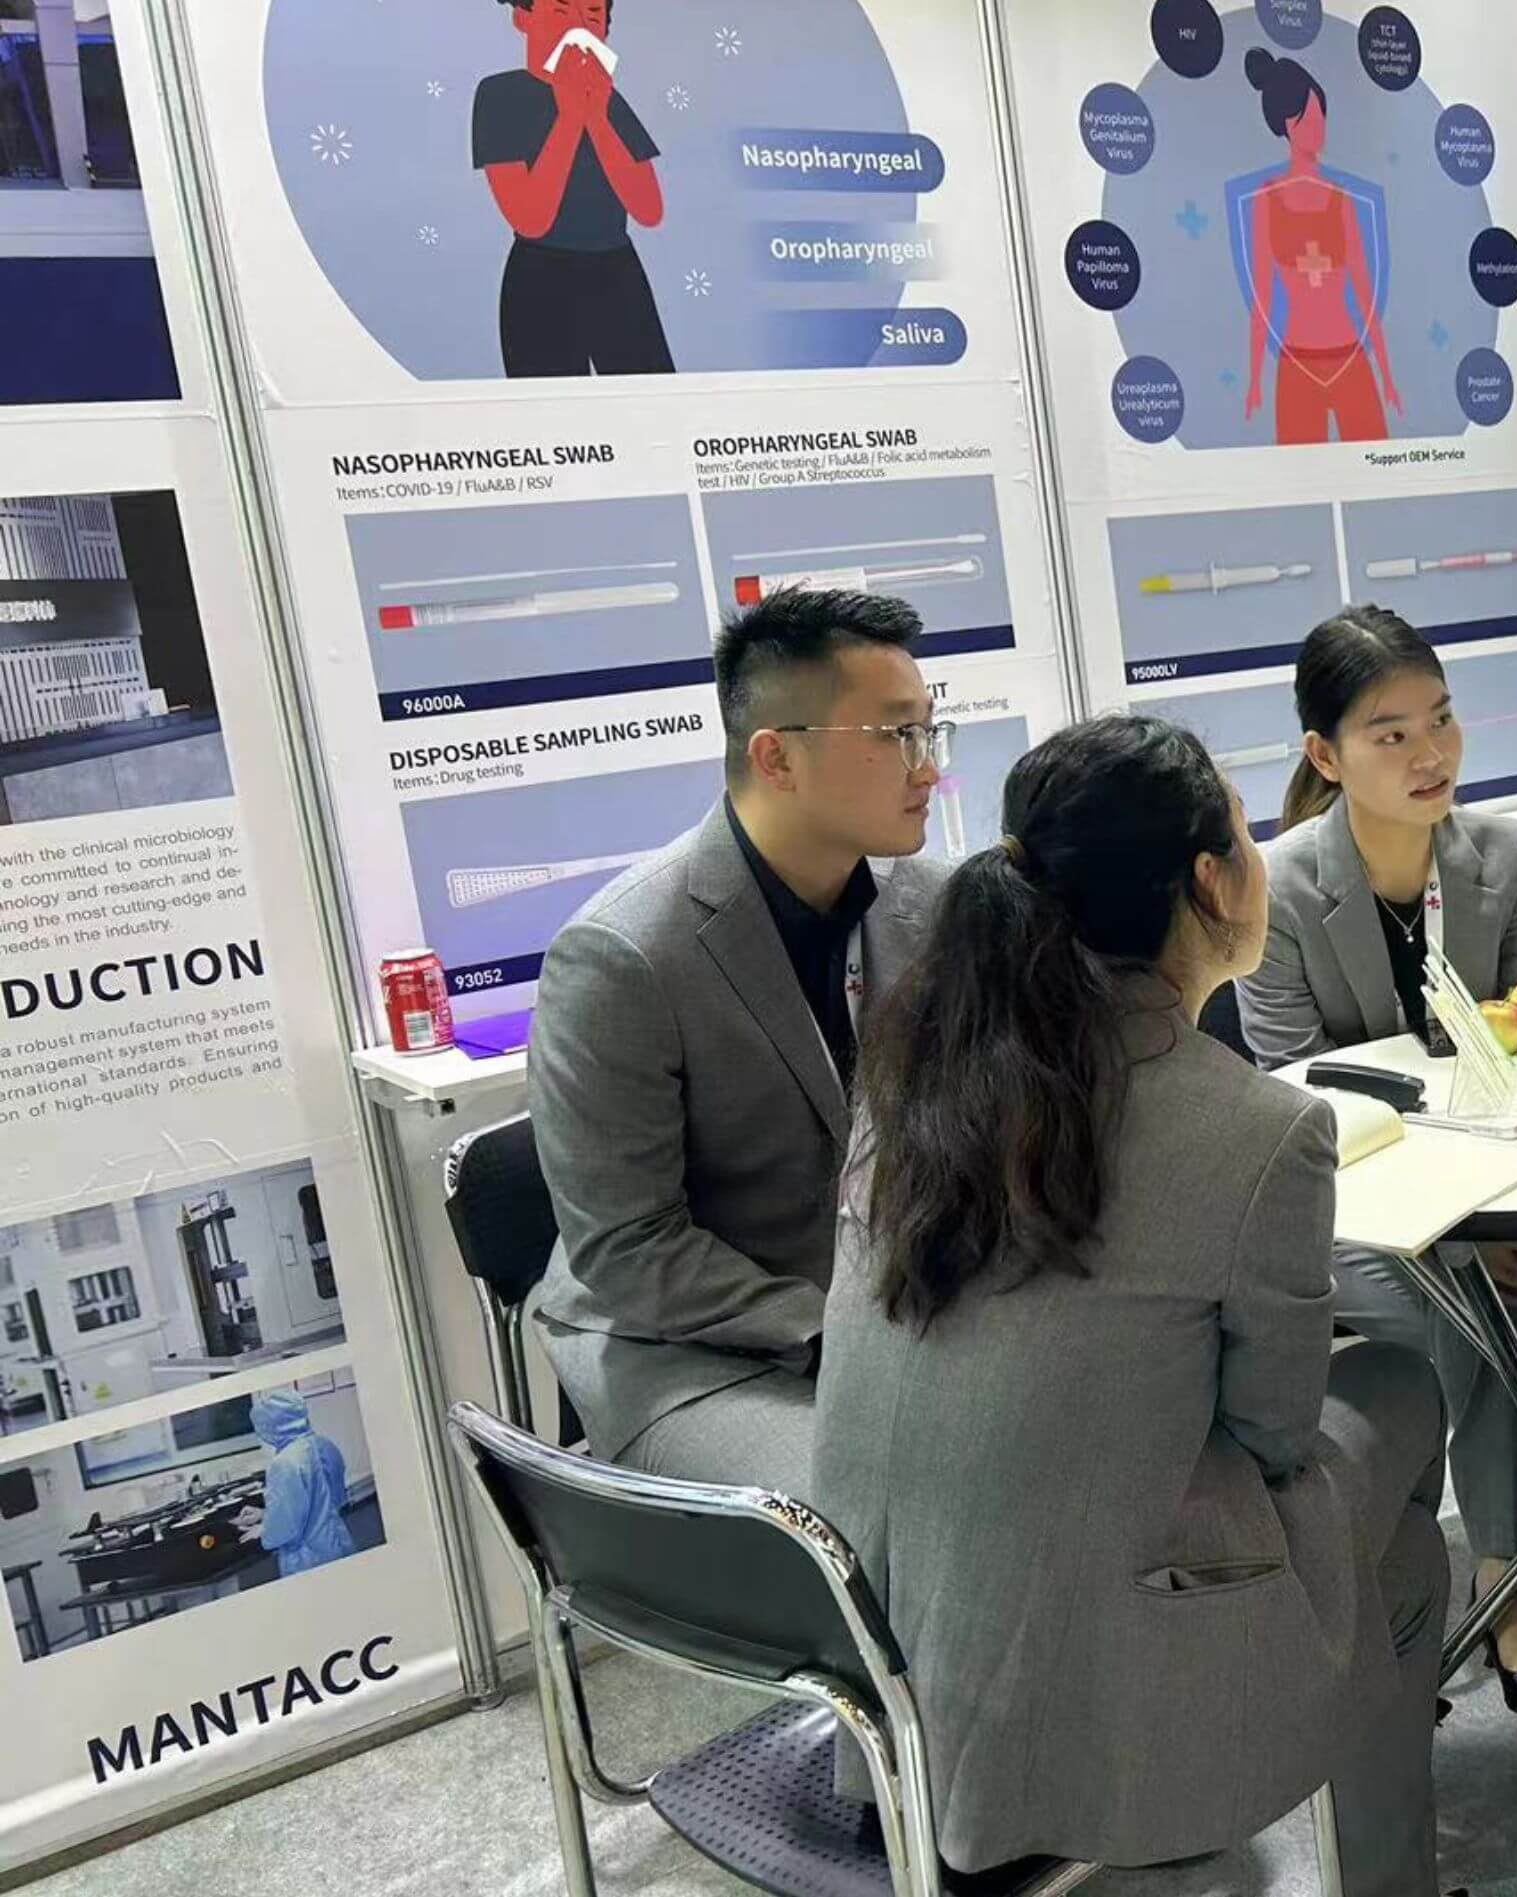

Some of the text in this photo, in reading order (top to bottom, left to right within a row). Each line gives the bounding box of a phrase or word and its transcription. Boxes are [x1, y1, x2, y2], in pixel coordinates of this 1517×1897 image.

[1178, 29, 1197, 41] HIV
[1380, 24, 1396, 37] TCT
[1084, 112, 1149, 128] Mycoplasma
[1089, 128, 1147, 143] Genitalium
[1450, 125, 1481, 137] Human
[1106, 147, 1133, 160] Virus
[1441, 140, 1492, 155] Mycoplasma
[742, 144, 923, 176] Nasopharyngeal
[1457, 156, 1479, 168] Virus
[770, 237, 934, 264] Oropharyngeal
[1081, 243, 1120, 257] Human
[1077, 260, 1129, 275] Papilloma
[1092, 277, 1119, 290] Virus
[881, 323, 945, 345] Saliva
[1117, 382, 1178, 398] Ureaplasma
[1467, 376, 1501, 388] Prostate
[1119, 398, 1179, 413] Urealyticum
[1472, 391, 1500, 403] Cancer
[693, 429, 917, 457] OROPHARYNGEAL SWAB
[332, 443, 615, 476] NASOPHARYNGEAL SWAB
[781, 456, 820, 471] testing
[828, 453, 869, 466] FluA&B
[877, 451, 902, 463] Folic
[905, 449, 927, 462] acid
[929, 446, 991, 461] metabolism
[1410, 450, 1430, 463] OEM
[1432, 448, 1465, 461] Service
[465, 477, 516, 493] FluA&B
[527, 475, 554, 490] RSV
[698, 477, 720, 489] test
[729, 474, 750, 487] HIV
[759, 472, 795, 486] Group
[797, 470, 805, 482] A
[1131, 663, 1178, 680] 95000LV
[402, 693, 466, 714] 96000A
[973, 698, 1010, 711] testing
[389, 713, 704, 771] DISPOSABLE SAMPLING SWAB
[477, 760, 525, 782] testing
[0, 825, 234, 868] with the clinical microbiology
[21, 864, 108, 887] committed
[115, 860, 131, 873] to
[139, 848, 211, 870] continual
[219, 846, 239, 860] in-
[67, 885, 98, 902] and
[104, 875, 175, 896] research
[181, 868, 211, 885] and
[216, 865, 242, 880] de-
[0, 884, 247, 934] ing the most cutting-edge and
[55, 933, 70, 947] in
[75, 928, 101, 944] the
[106, 917, 173, 940] industry.
[1, 938, 265, 1019] DUCTION
[454, 968, 503, 990] 93052
[1, 999, 271, 1058] a robust manufacturing system
[119, 1035, 181, 1061] system
[186, 1029, 219, 1046] that
[224, 1018, 275, 1039] meets
[203, 1037, 279, 1063] Ensuring
[29, 1100, 46, 1117] of
[55, 1081, 160, 1114] high-quality
[169, 1066, 243, 1093] products
[252, 1057, 283, 1074] and
[86, 1635, 399, 1784] MANTACC
